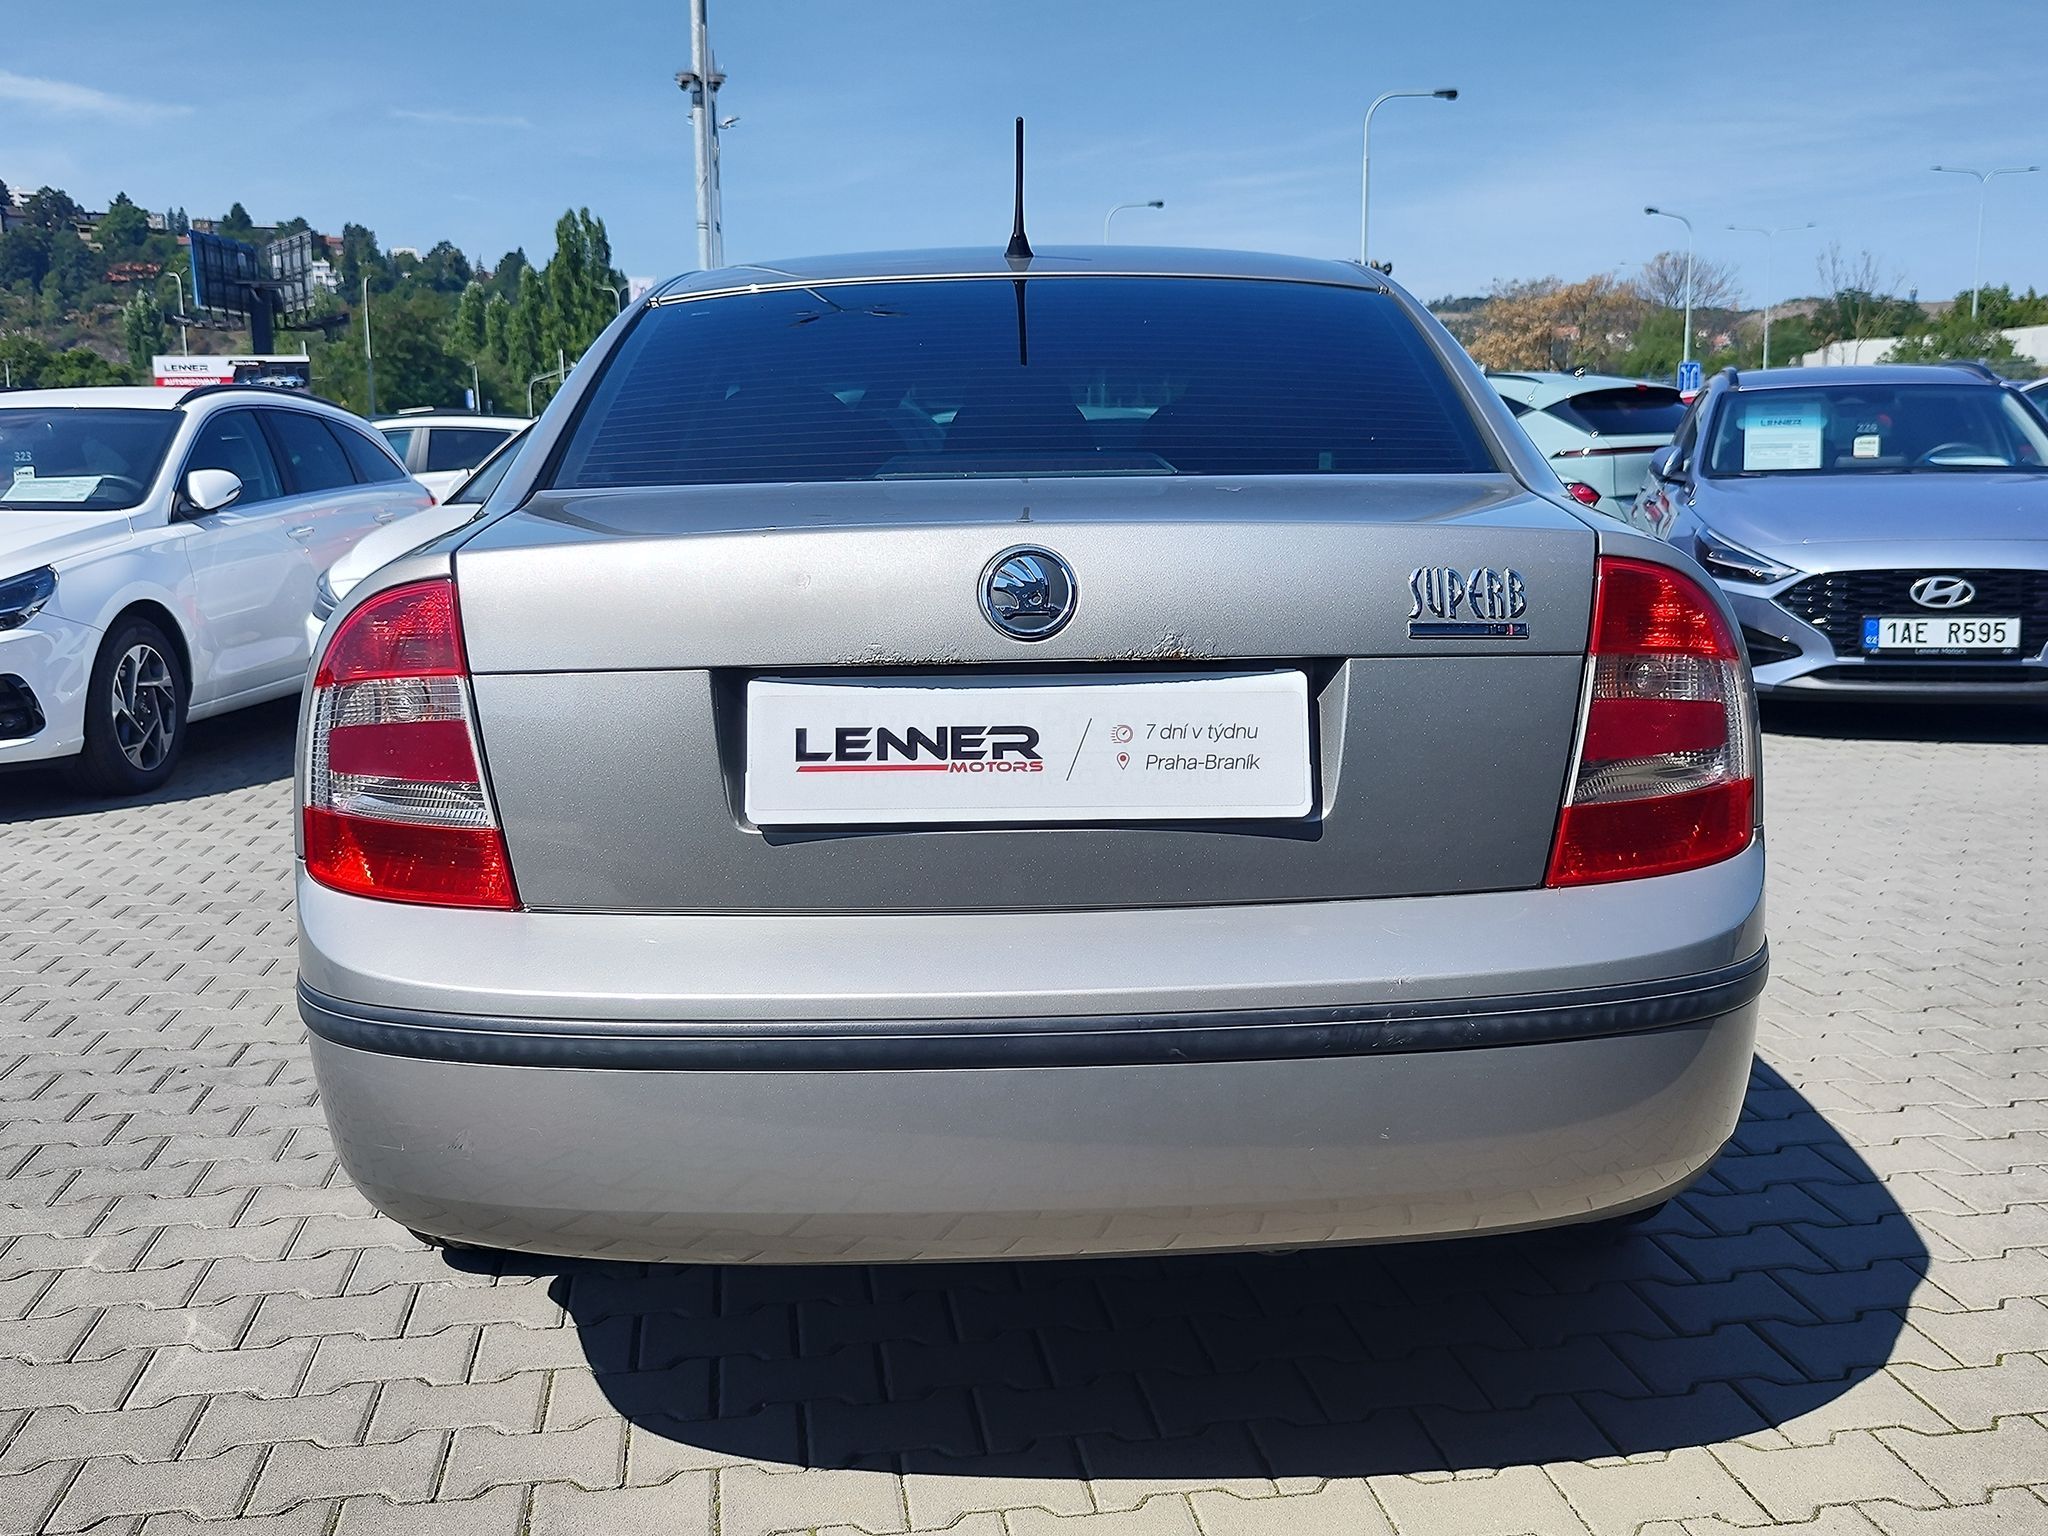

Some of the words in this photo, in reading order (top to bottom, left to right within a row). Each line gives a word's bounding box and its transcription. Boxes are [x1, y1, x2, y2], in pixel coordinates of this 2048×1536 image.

[164, 364, 208, 372] LENNER
[14, 451, 32, 462] 323
[1408, 566, 1528, 620] SUPERB
[1887, 622, 1928, 644] 1AE
[1948, 621, 2007, 643] R595
[1146, 723, 1156, 739] 7
[1160, 723, 1189, 740] dní
[1192, 727, 1203, 739] v
[1208, 722, 1259, 743] týdnu
[795, 725, 1043, 762] LENNER
[949, 761, 1043, 773] MOTORS
[1145, 753, 1261, 770] Praha-Braník
